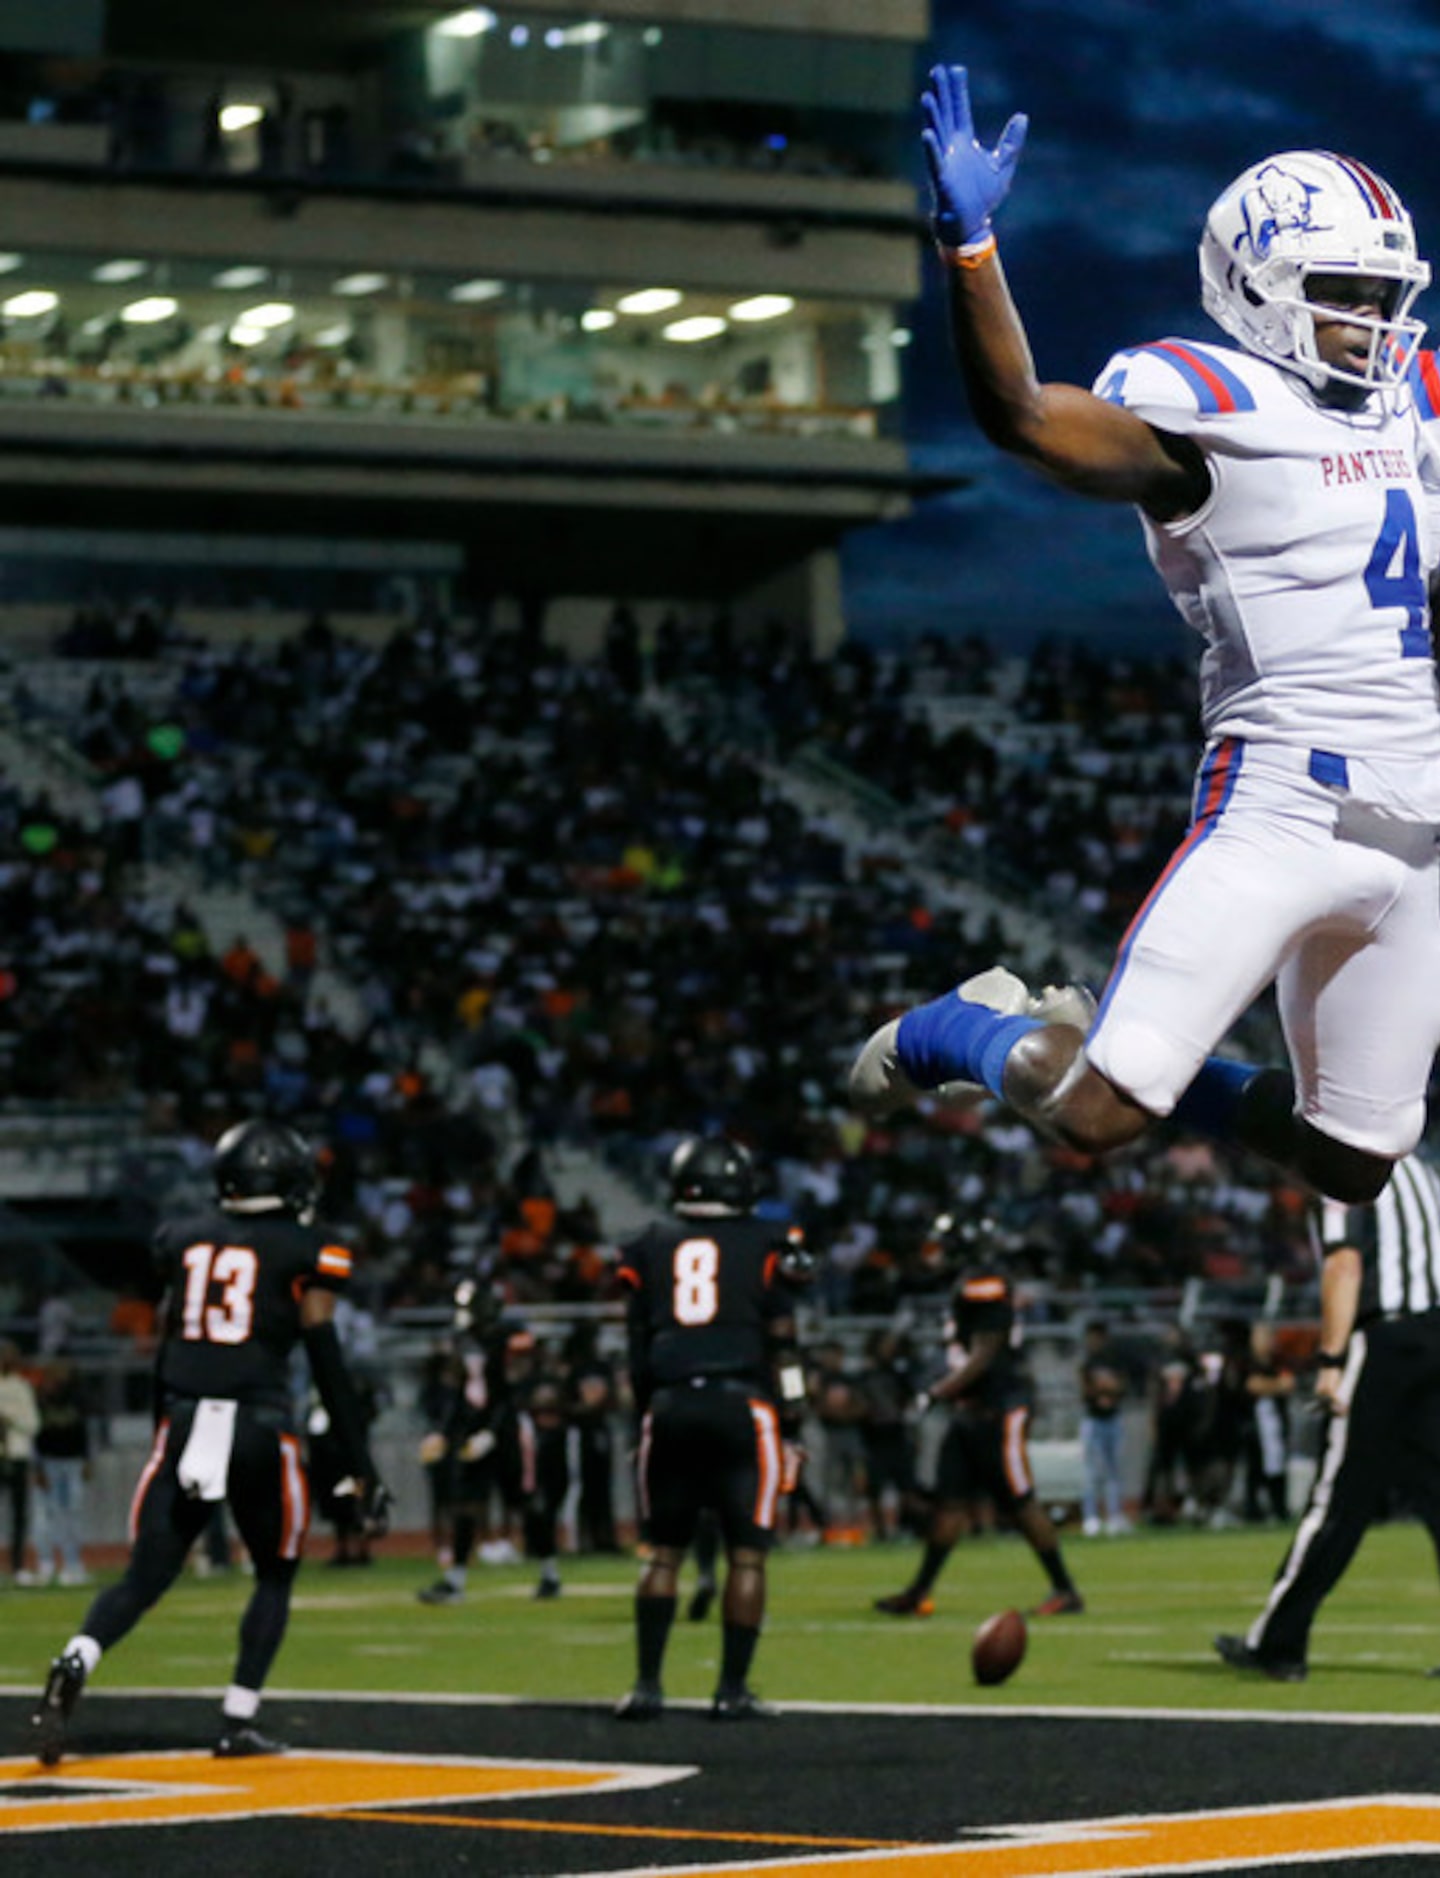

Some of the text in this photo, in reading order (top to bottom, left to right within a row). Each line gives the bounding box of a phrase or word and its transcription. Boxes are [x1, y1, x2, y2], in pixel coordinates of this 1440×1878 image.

[1364, 489, 1432, 658] 4
[182, 1243, 258, 1345] 13
[673, 1236, 719, 1327] 8
